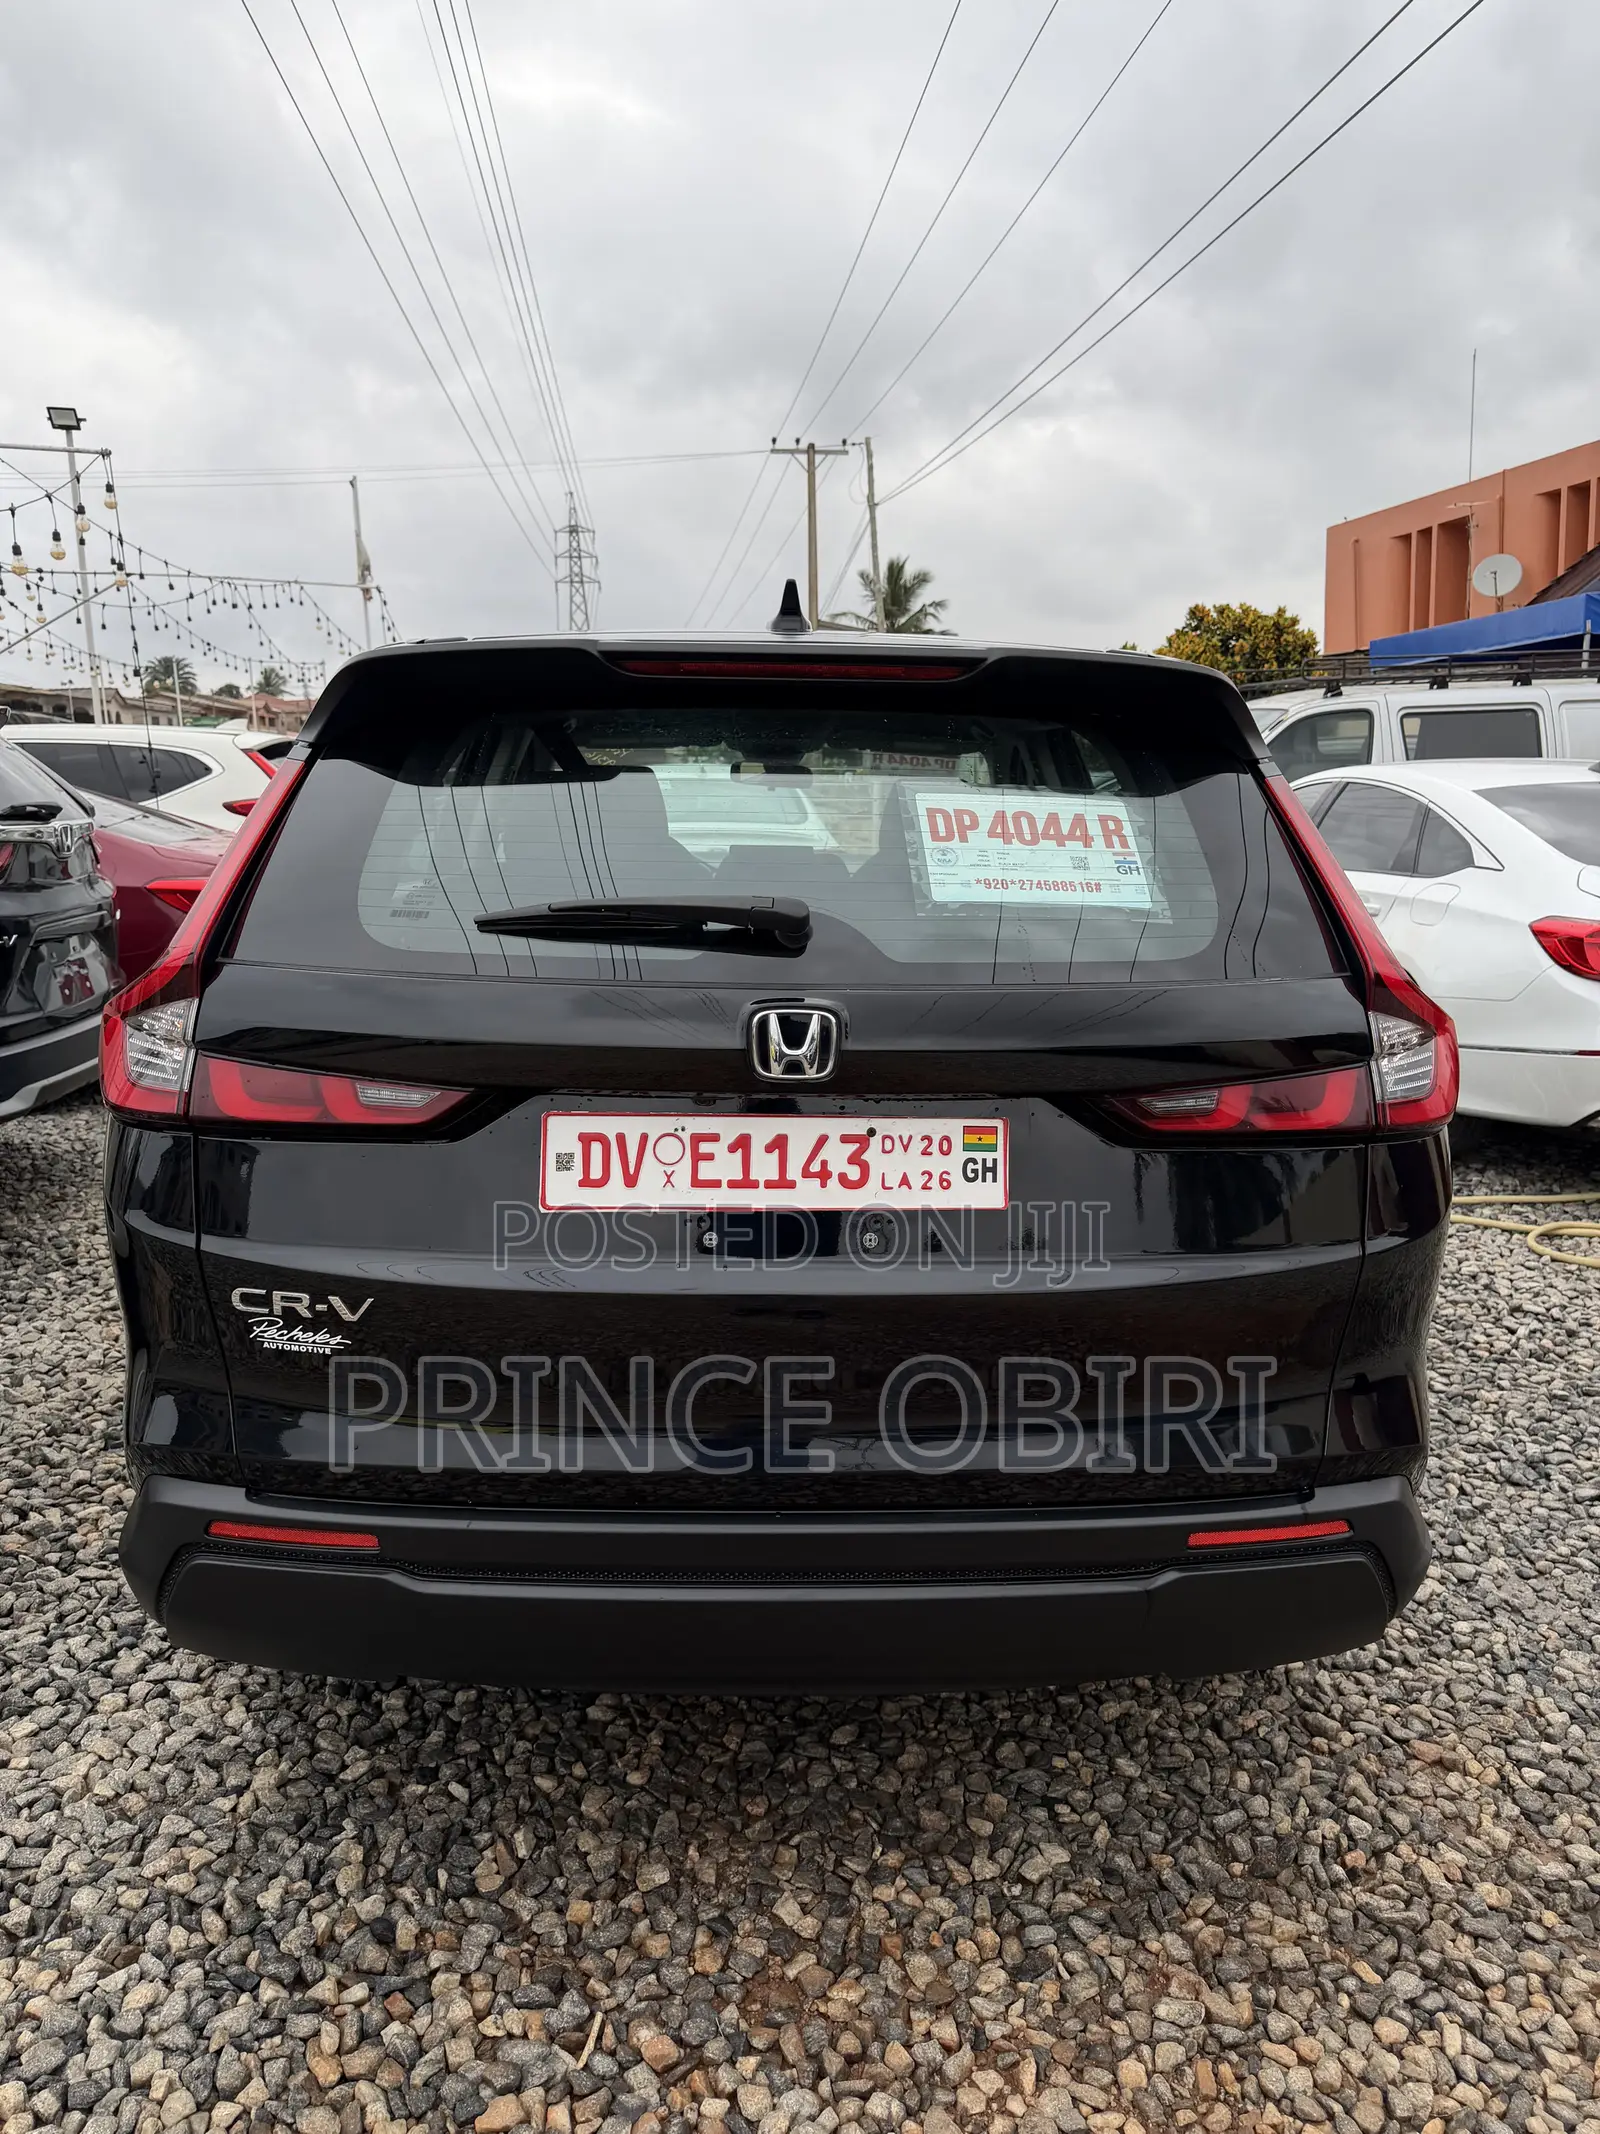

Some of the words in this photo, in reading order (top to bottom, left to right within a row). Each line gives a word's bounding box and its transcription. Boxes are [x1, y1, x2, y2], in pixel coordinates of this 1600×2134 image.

[925, 807, 980, 843] DP
[987, 810, 1095, 848] 4044
[1097, 814, 1131, 849] R
[1116, 865, 1141, 875] GH
[577, 1132, 649, 1188] DV
[690, 1132, 871, 1190] E1143
[962, 1157, 998, 1183] GH
[230, 1287, 375, 1322] CR-V
[247, 1316, 352, 1345] Pecheles
[263, 1341, 332, 1355] AUTOMOTIVE
